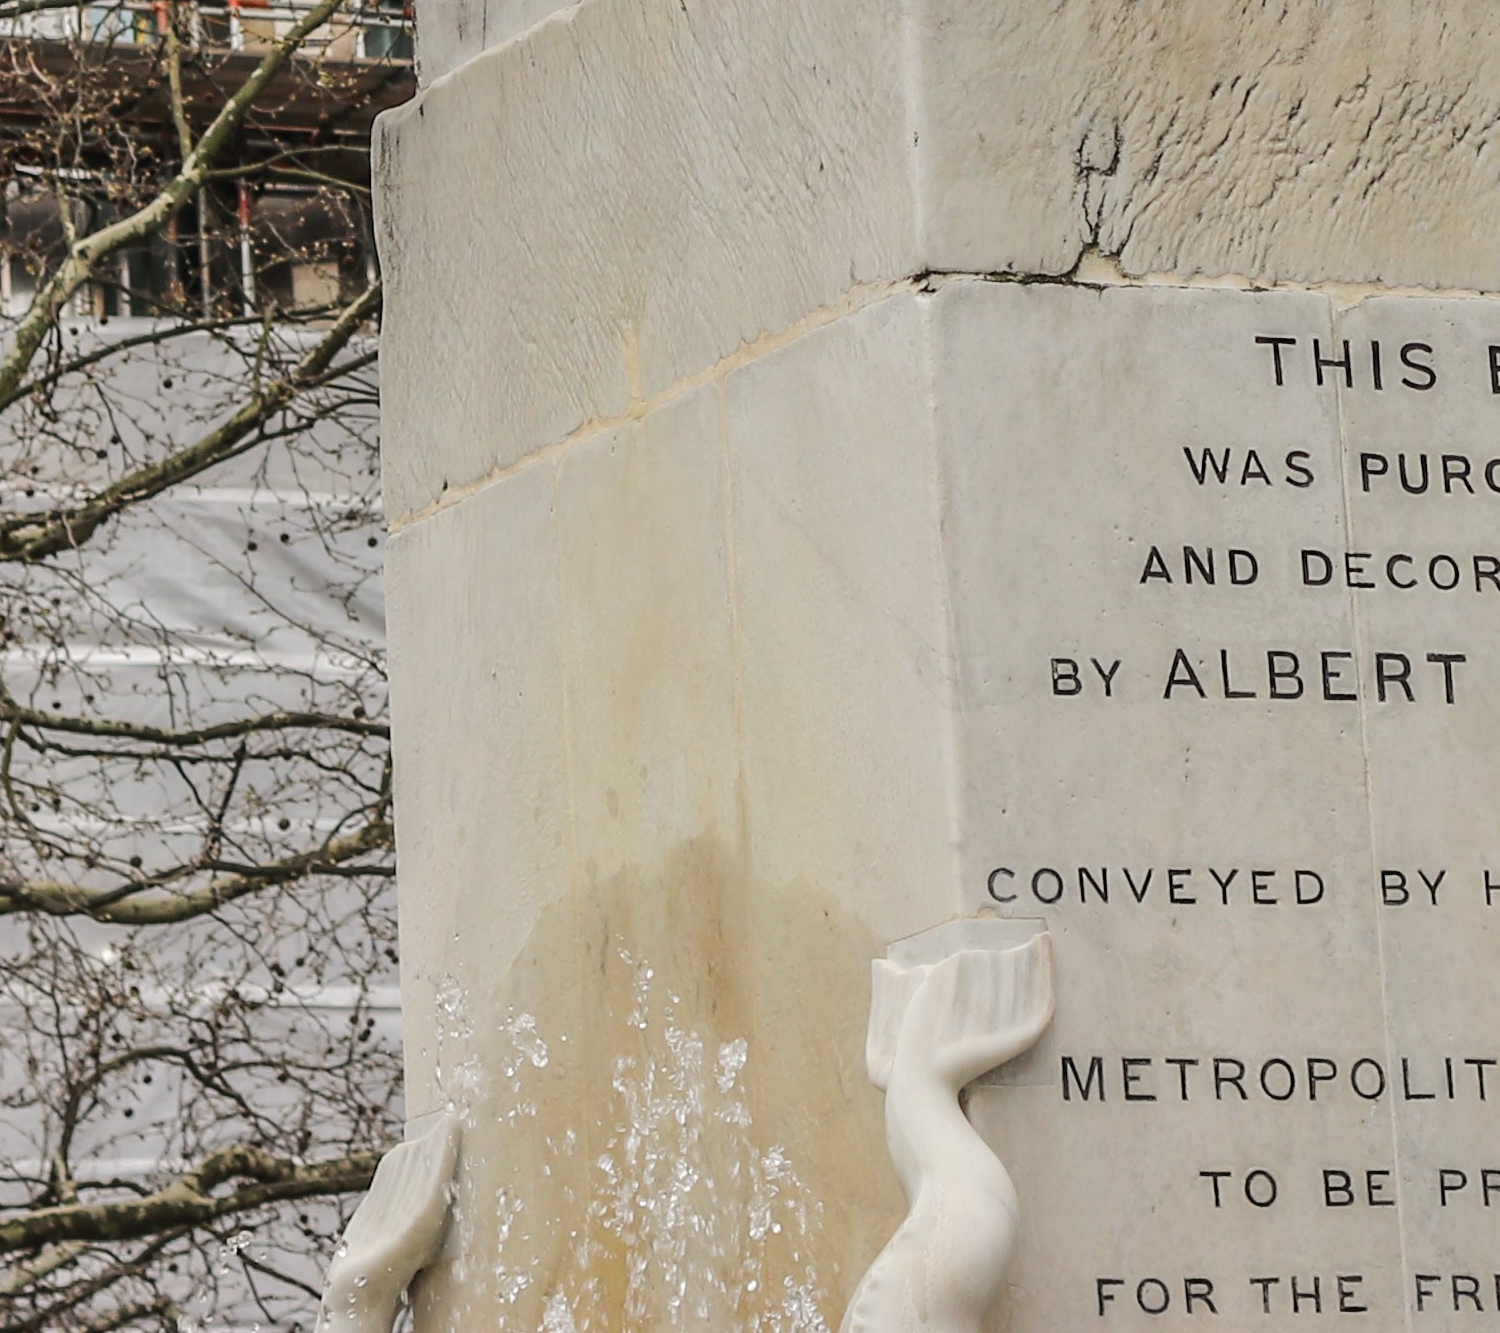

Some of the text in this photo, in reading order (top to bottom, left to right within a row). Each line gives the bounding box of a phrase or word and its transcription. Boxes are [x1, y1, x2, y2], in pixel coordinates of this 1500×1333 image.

[1255, 336, 1437, 391] THIS
[1183, 446, 1314, 488] WAS
[1140, 545, 1258, 585] AND
[1050, 658, 1120, 697] BY
[1163, 648, 1467, 704] ALBERT
[987, 867, 1324, 905] CONVEYED
[1380, 870, 1446, 906] BY
[1199, 1169, 1277, 1208] TO
[1322, 1169, 1395, 1207] BE
[1096, 1278, 1217, 1317] FOR
[1249, 1275, 1368, 1314] THE
